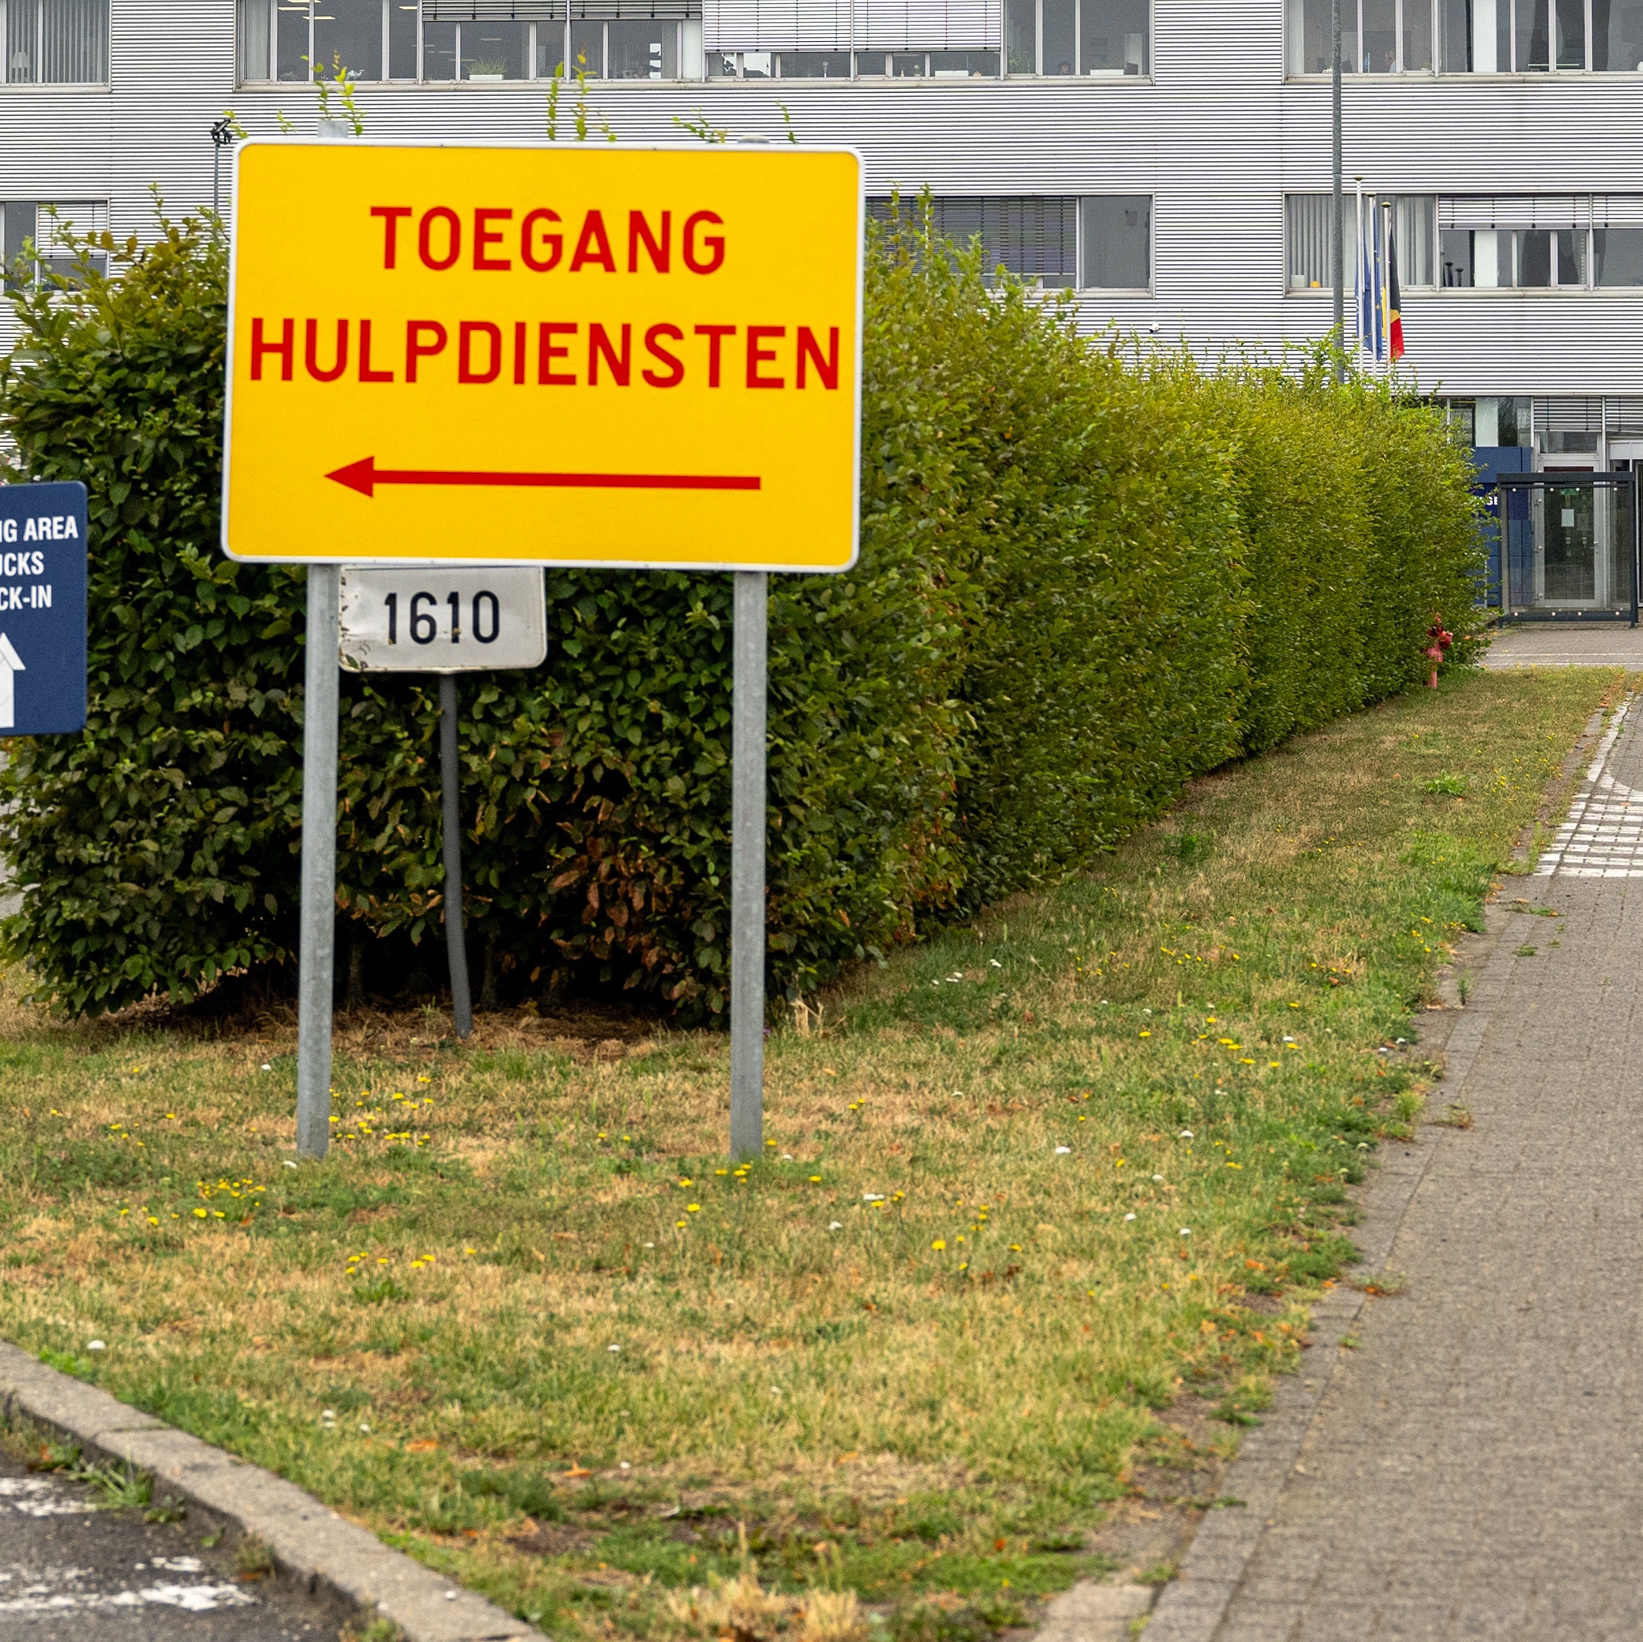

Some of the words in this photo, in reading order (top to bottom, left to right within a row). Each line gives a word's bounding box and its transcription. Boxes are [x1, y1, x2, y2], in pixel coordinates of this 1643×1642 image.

[369, 205, 726, 276] TOEGANG
[249, 316, 840, 391] HULPDIENSTEN
[22, 515, 79, 542] AREA
[383, 589, 501, 646] 1610
